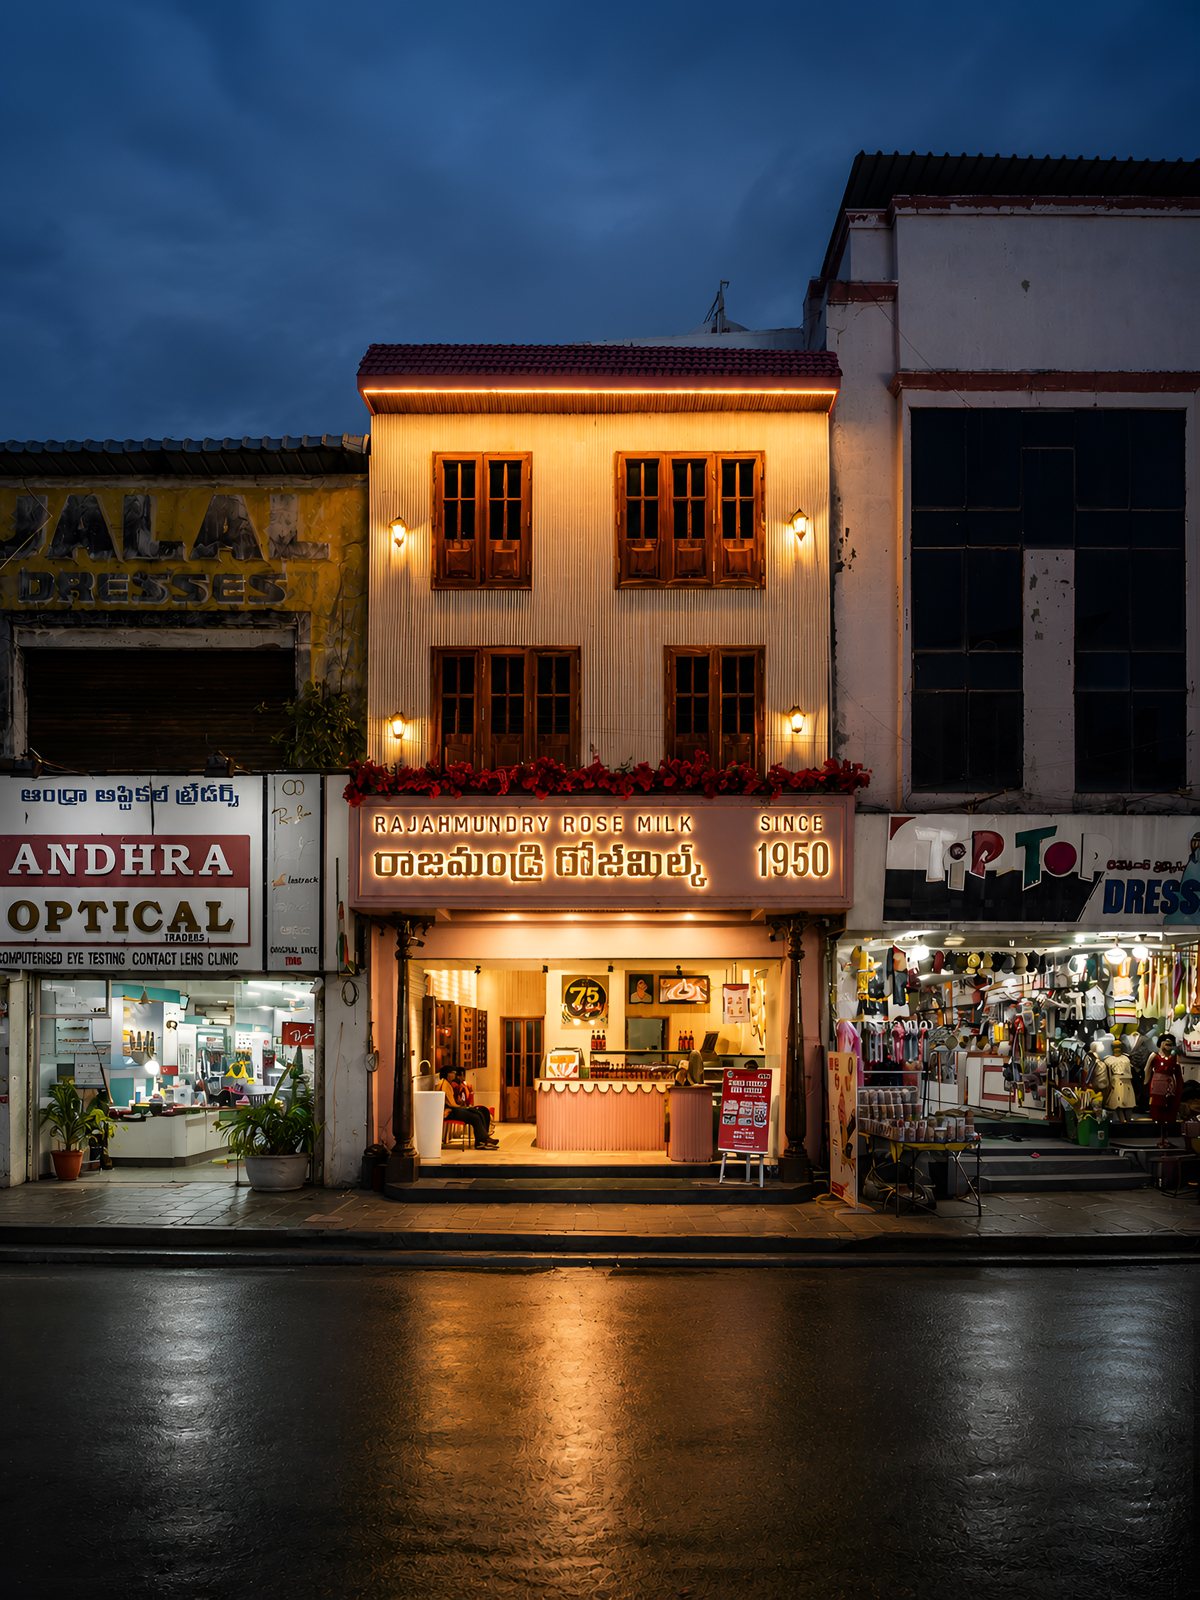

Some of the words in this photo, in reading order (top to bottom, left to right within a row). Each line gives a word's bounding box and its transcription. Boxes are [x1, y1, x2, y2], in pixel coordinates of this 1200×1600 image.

[18, 570, 289, 605] DRESSES
[375, 816, 549, 833] RAJAHMUNDRY
[563, 816, 623, 832] ROSE
[637, 816, 692, 832] MILK
[760, 815, 823, 832] SINCE
[8, 843, 233, 876] ANDHRA
[758, 841, 830, 877] 1950
[8, 900, 235, 932] OPTICAL
[164, 933, 205, 943] TRADERS
[67, 952, 84, 965] EYE
[88, 952, 125, 965] TESTING
[132, 952, 177, 966] CONTACT
[180, 952, 204, 966] LENS
[208, 952, 239, 966] CLINIC
[569, 986, 600, 1007] 75
